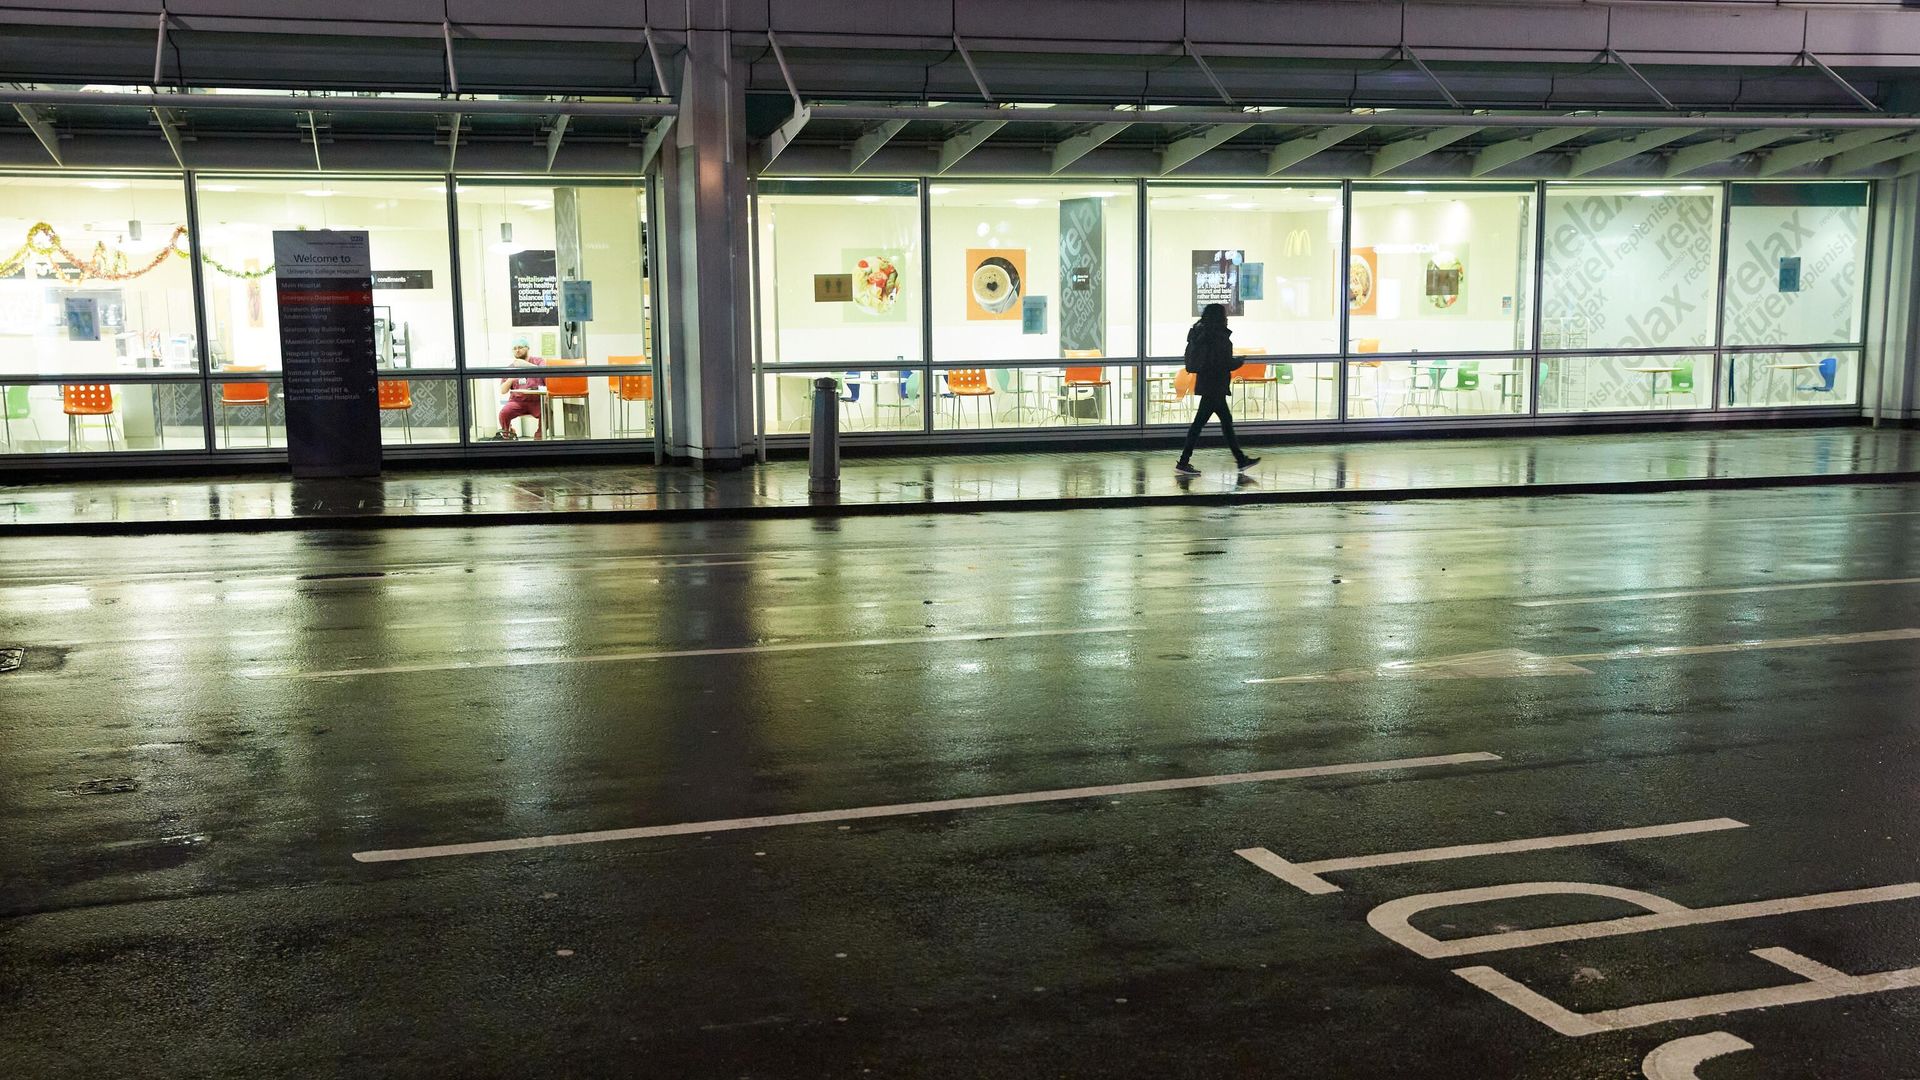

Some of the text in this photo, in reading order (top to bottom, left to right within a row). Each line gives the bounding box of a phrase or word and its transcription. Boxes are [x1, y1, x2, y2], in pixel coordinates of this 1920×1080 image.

[293, 254, 352, 264] Welcome to
[1727, 209, 1815, 312] relax
[1796, 232, 1853, 298] eplenish
[286, 267, 360, 276] University College Hospital
[298, 281, 321, 289] Hospital
[534, 282, 555, 290] healthy
[1543, 240, 1614, 325] efuel
[282, 295, 350, 303] Emergency Department
[312, 313, 328, 321] Wing
[308, 326, 321, 334] Way
[321, 326, 346, 334] Building
[311, 350, 320, 358] for
[320, 350, 343, 358] Tropical
[319, 369, 336, 378] Sport
[305, 386, 330, 394] National
[334, 393, 360, 401] Hospitals
